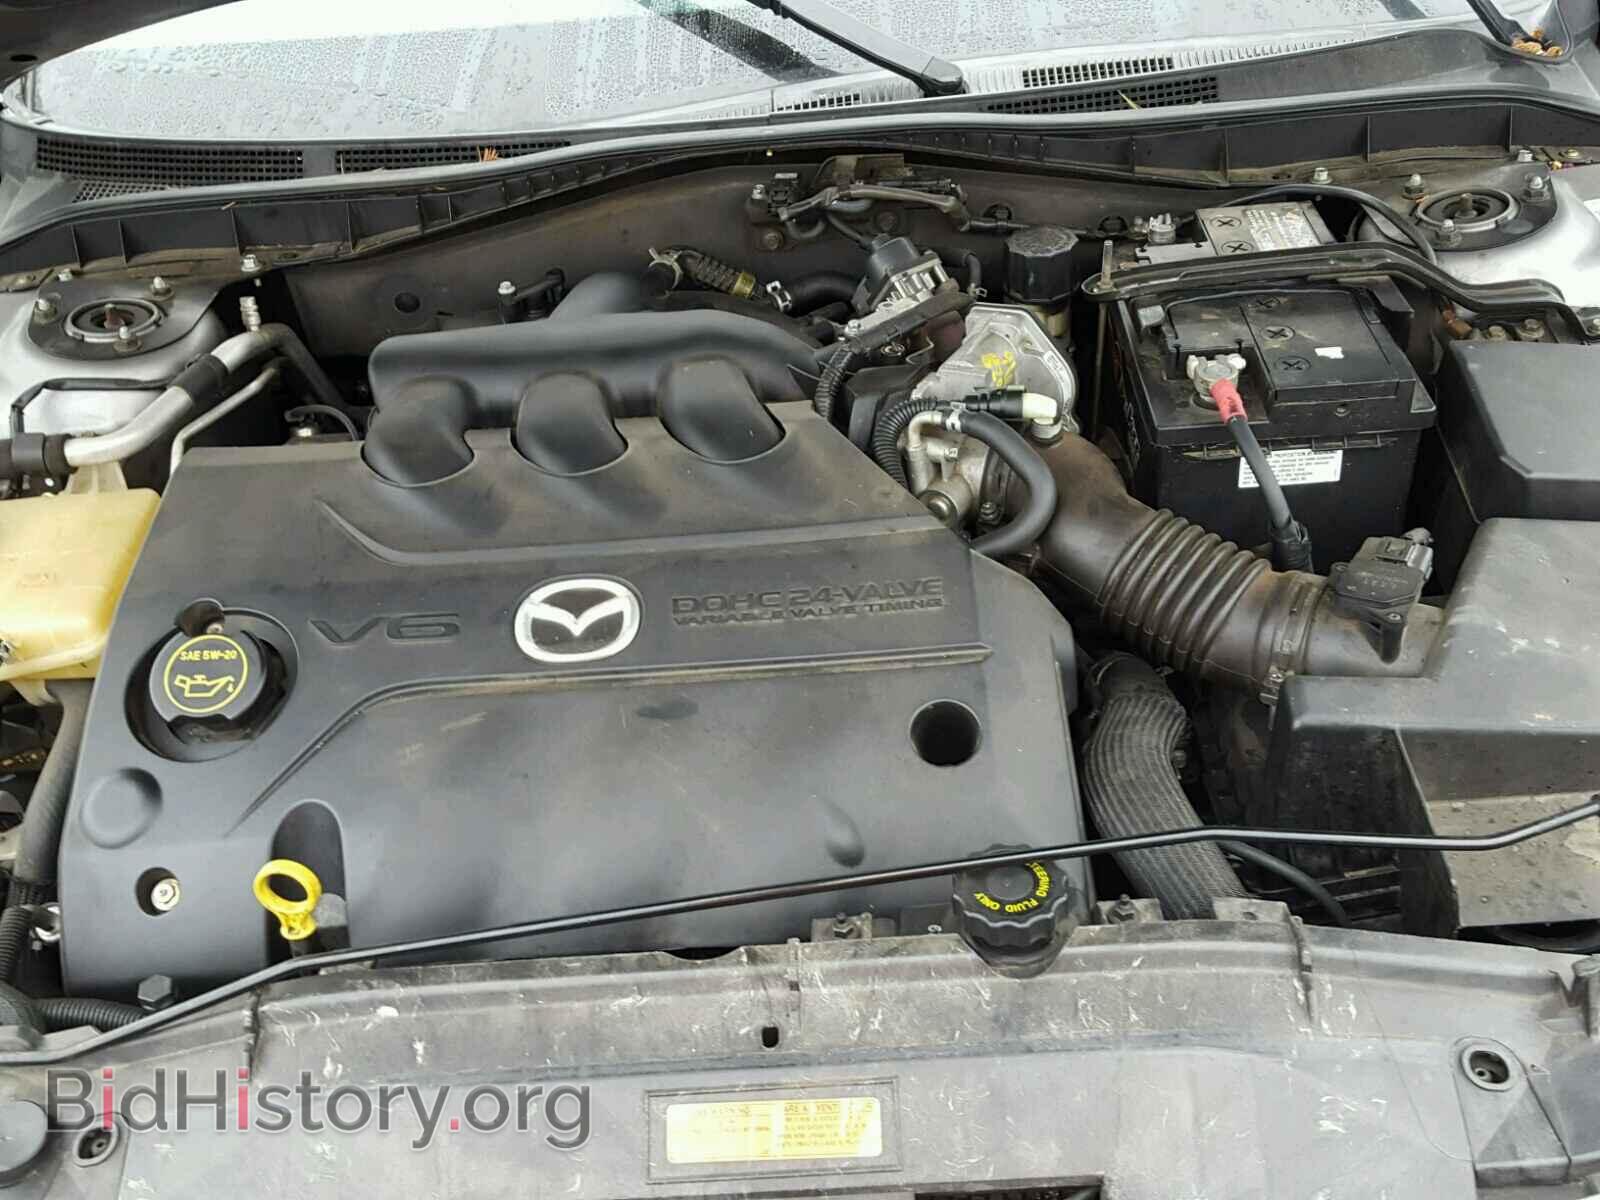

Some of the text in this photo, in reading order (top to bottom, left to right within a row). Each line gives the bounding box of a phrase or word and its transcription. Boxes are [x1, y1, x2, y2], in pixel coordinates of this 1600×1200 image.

[671, 577, 943, 615] DOHC 24-VALVE
[673, 598, 943, 625] VARIABLE VALVE TIMING
[310, 613, 461, 645] V6
[179, 649, 238, 661] SAE 5W-20
[974, 891, 1000, 911] ONLY
[1004, 897, 1039, 913] FLUID
